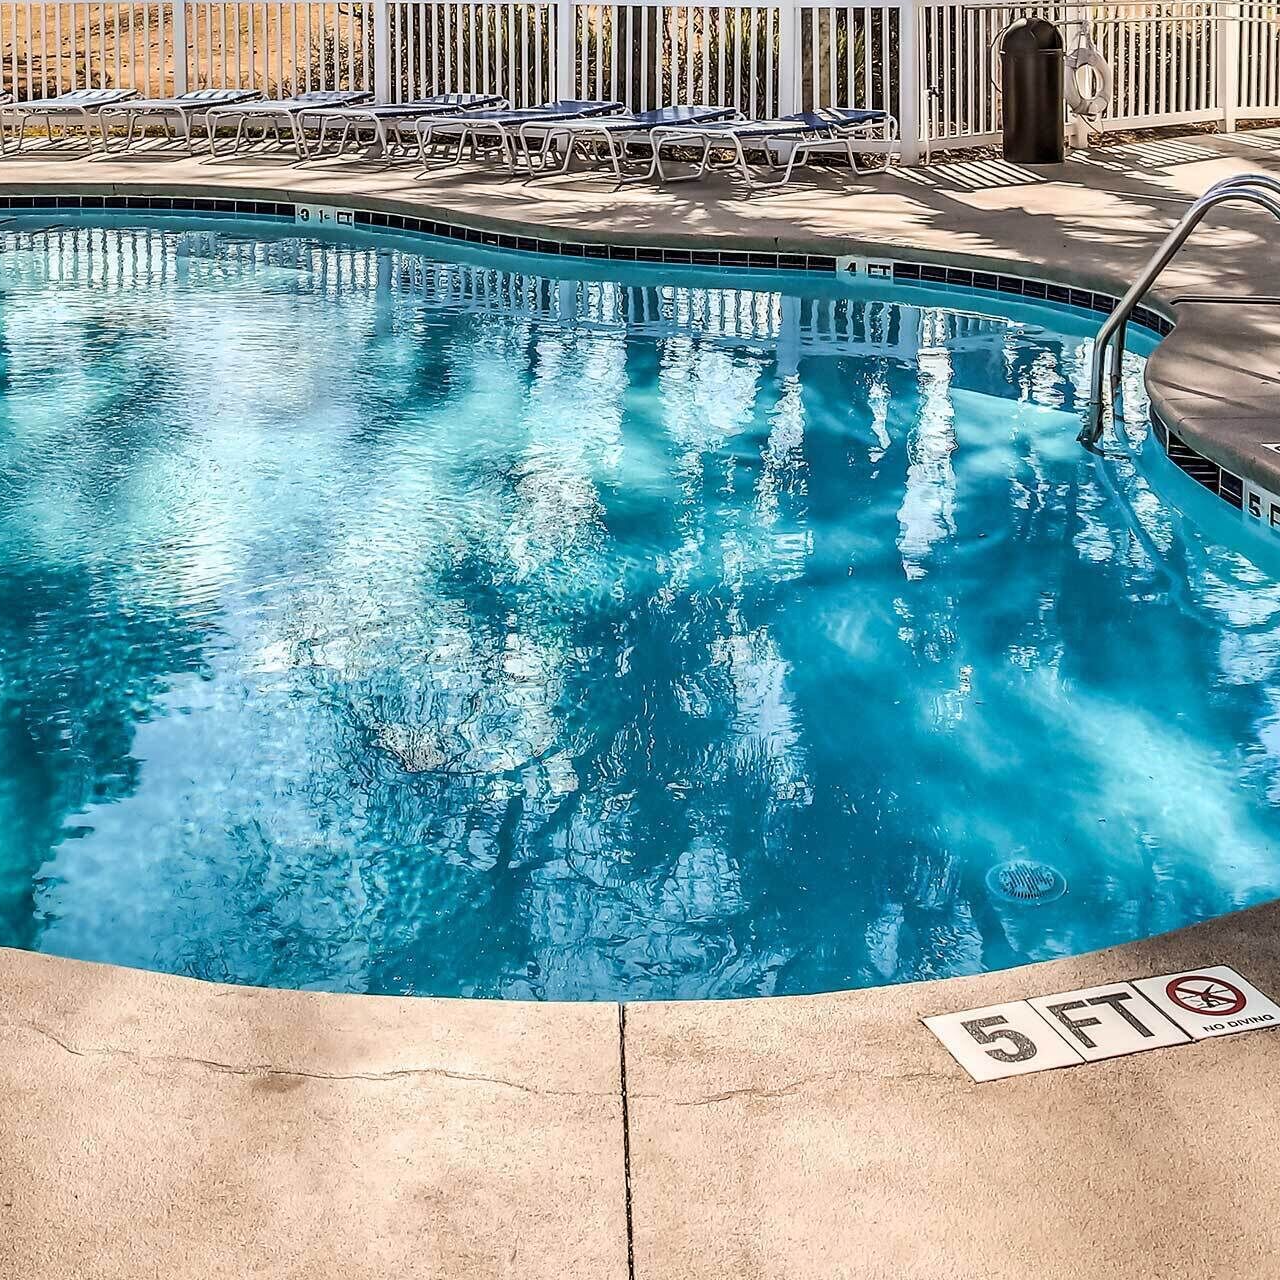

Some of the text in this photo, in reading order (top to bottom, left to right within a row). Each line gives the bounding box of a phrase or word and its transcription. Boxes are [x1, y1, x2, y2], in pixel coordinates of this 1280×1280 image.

[1248, 491, 1262, 518] 5
[960, 991, 1156, 1064] 5 FT
[1202, 1014, 1276, 1033] NO DIVING
